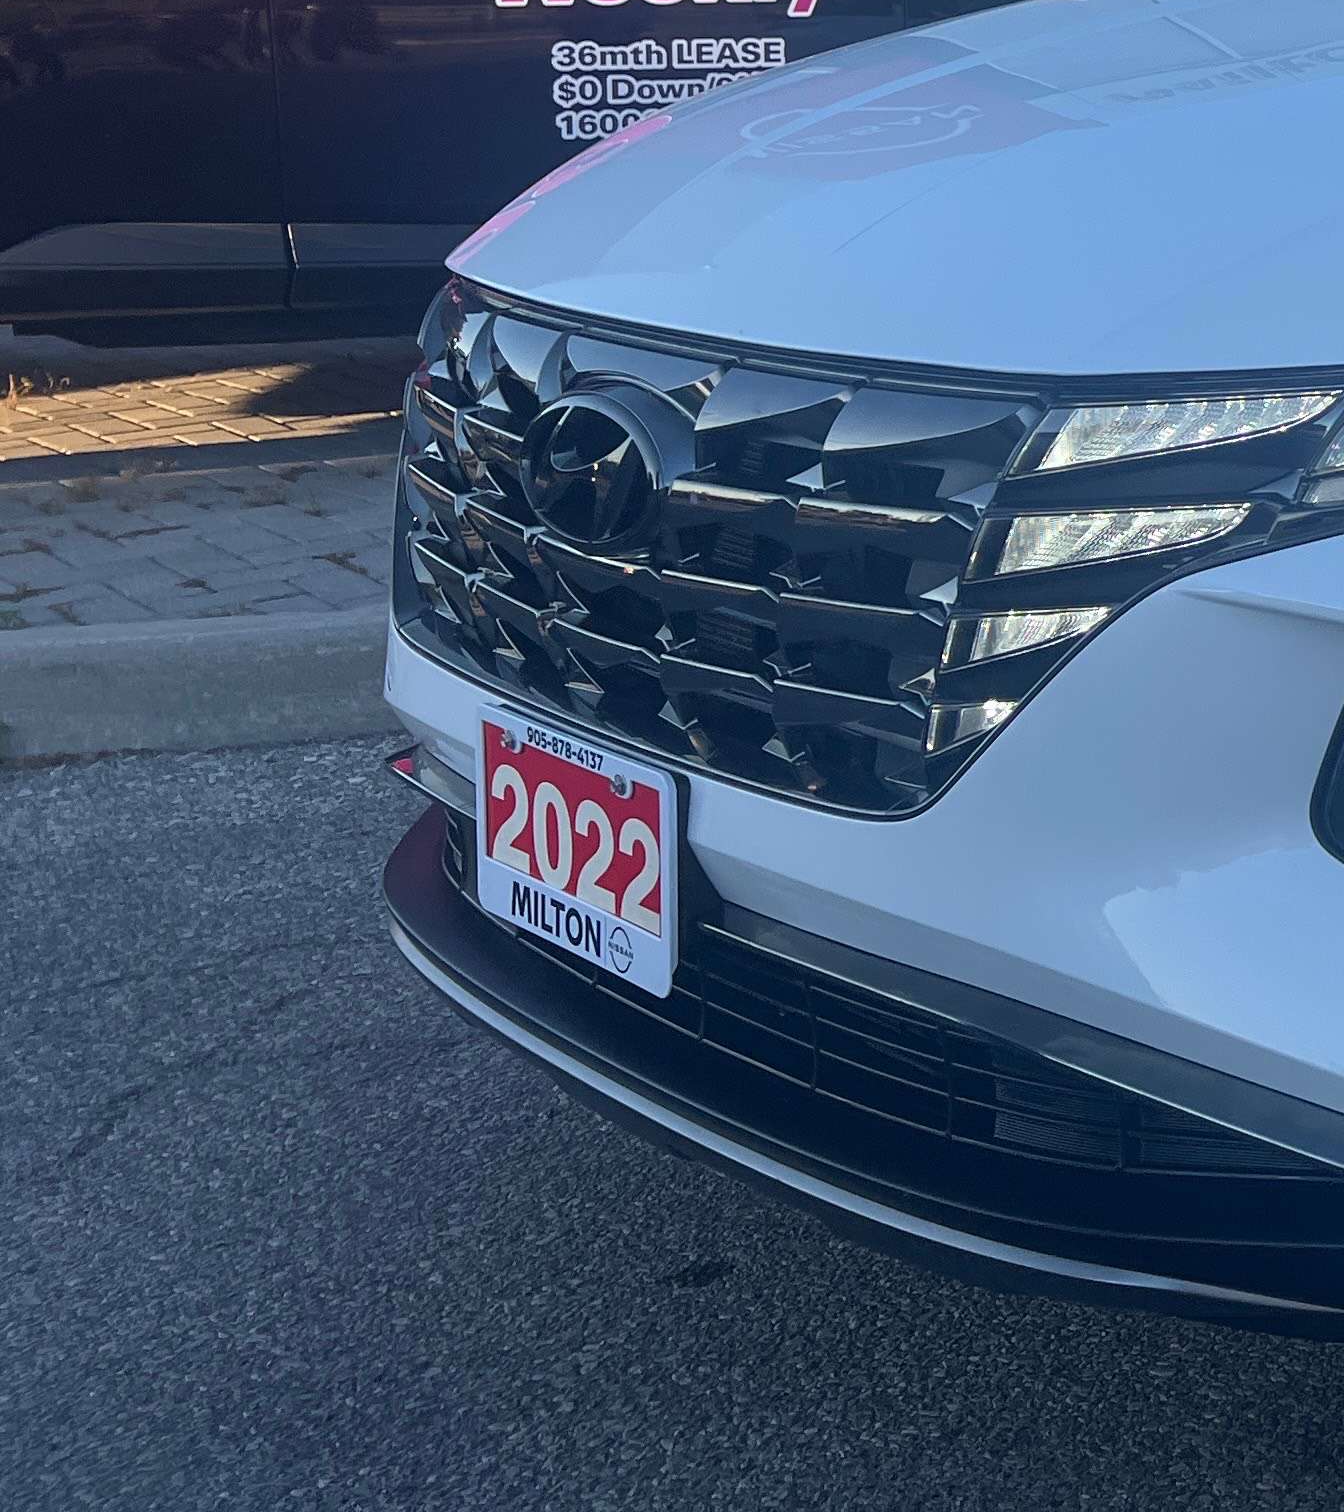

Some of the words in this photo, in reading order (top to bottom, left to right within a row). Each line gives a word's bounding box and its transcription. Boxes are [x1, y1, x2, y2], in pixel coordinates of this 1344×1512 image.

[552, 40, 667, 70] 36mth
[672, 38, 785, 68] LEASE
[553, 74, 602, 108] $0
[526, 726, 604, 771] 905-878-4137
[491, 764, 661, 937] 2022
[511, 880, 601, 958] MILTON
